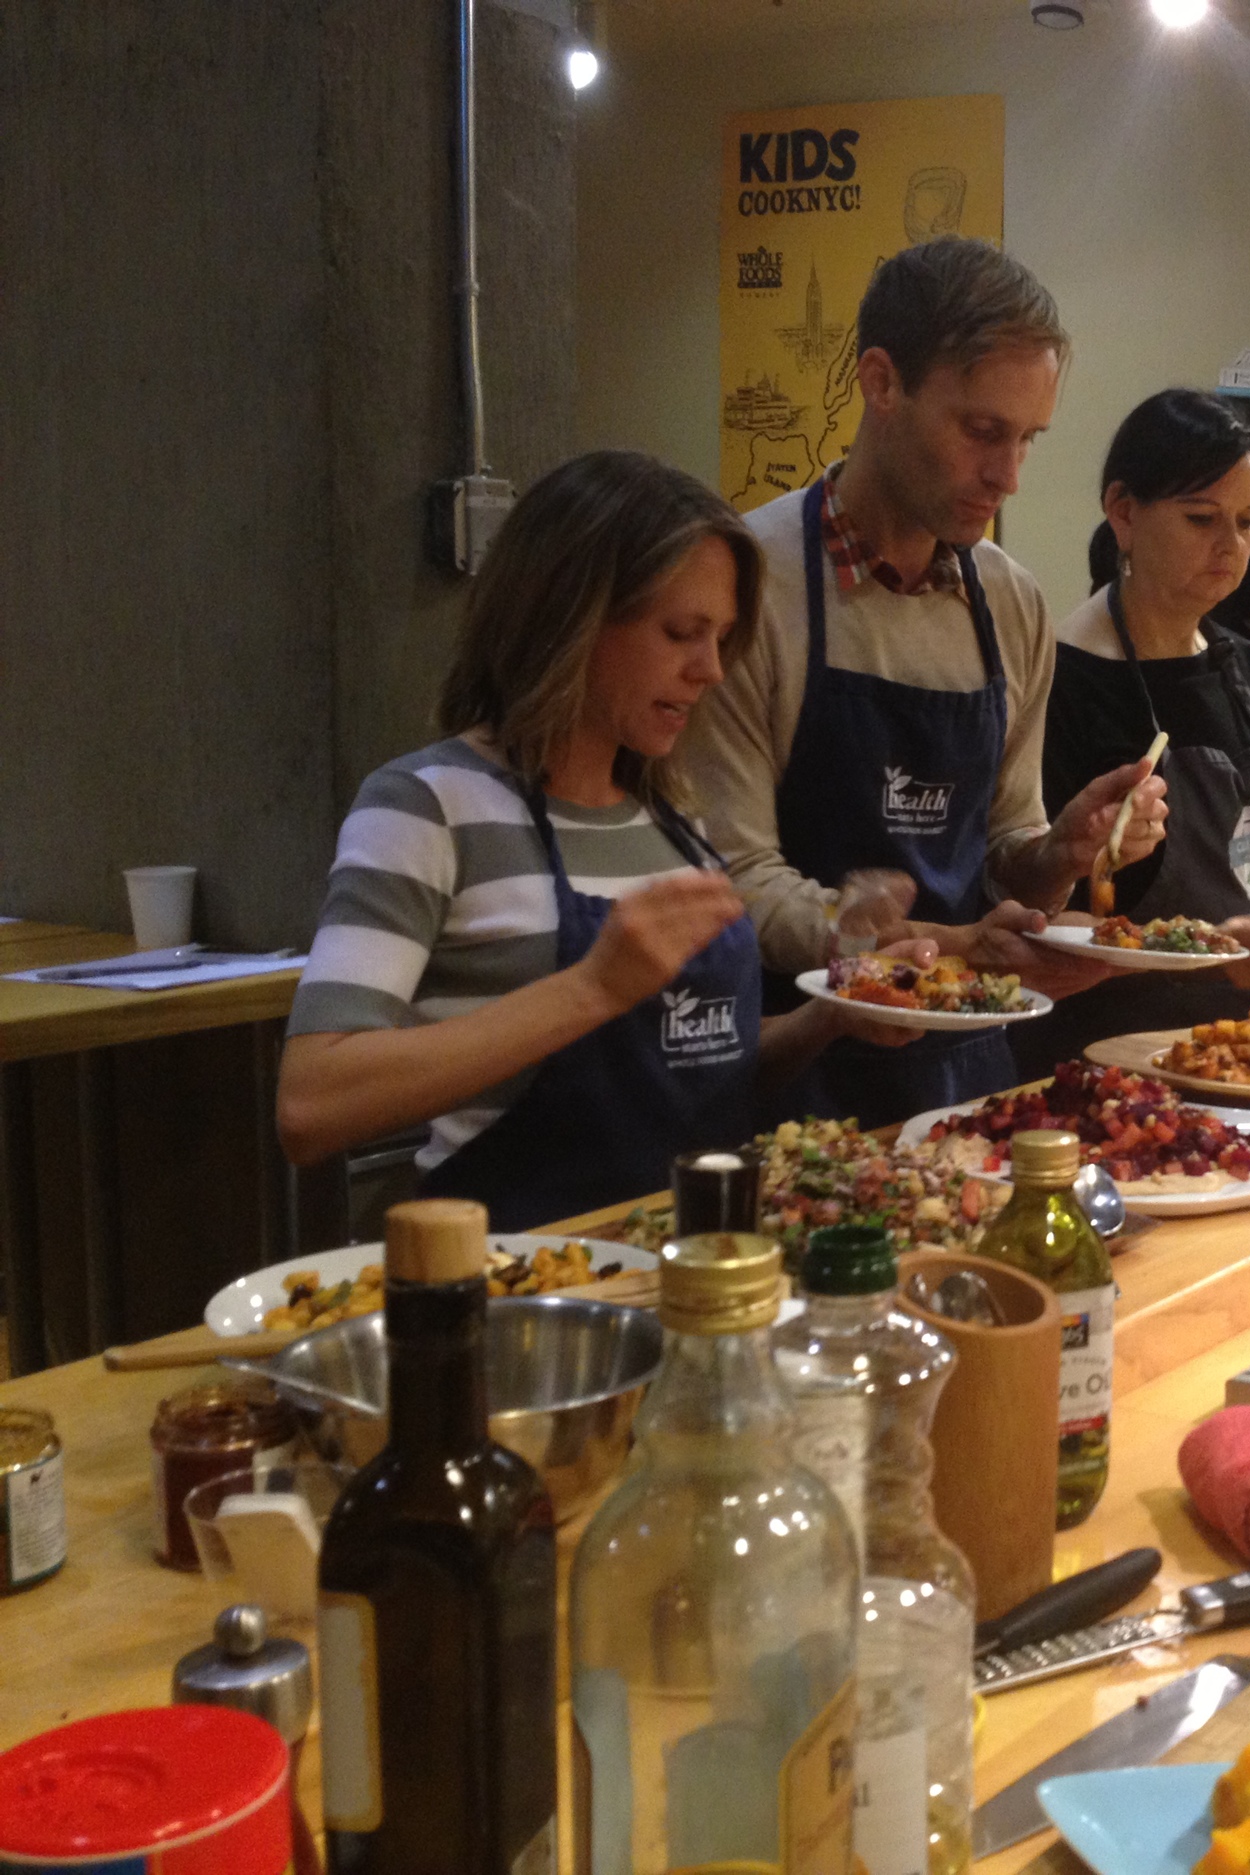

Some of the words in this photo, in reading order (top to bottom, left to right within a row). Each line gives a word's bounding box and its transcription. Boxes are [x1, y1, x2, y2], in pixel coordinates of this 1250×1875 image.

[740, 128, 860, 183] KIDS
[738, 185, 861, 216] COOKNYC!
[737, 251, 783, 265] WHOLE
[739, 266, 782, 281] FOODS
[887, 783, 946, 810] health
[668, 1005, 731, 1039] health
